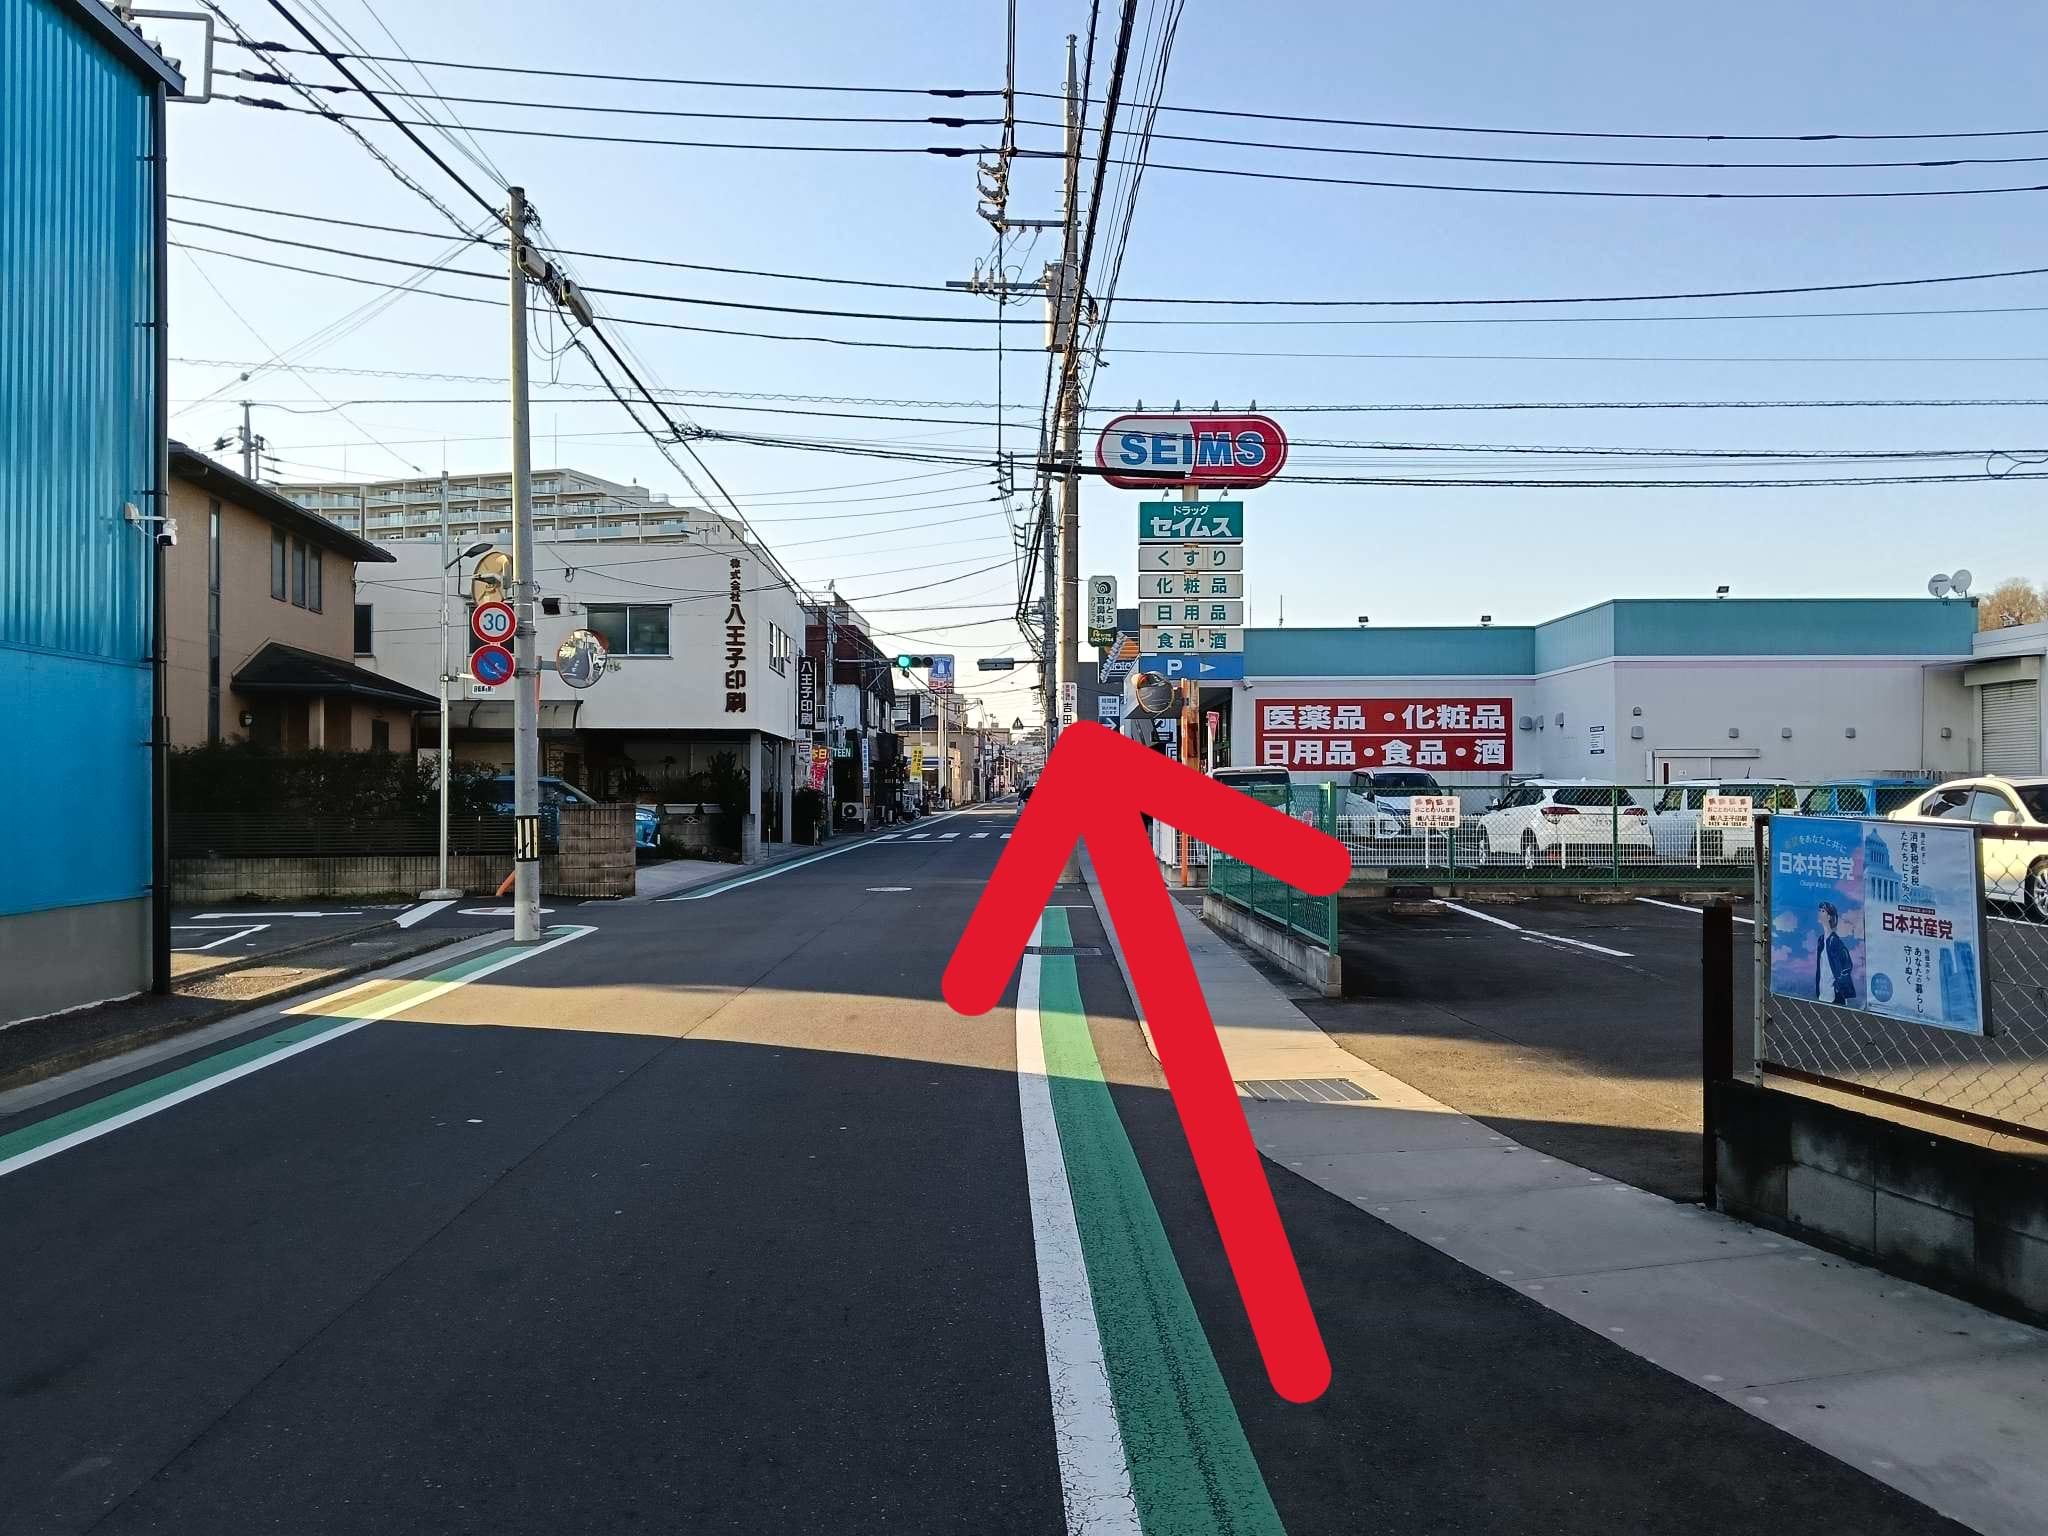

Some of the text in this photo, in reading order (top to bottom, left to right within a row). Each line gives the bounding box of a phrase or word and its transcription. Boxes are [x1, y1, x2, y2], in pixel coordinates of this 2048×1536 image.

[1119, 431, 1265, 467] SEIMS
[1173, 505, 1209, 515] ドラッグ
[1151, 517, 1232, 537] セイムス
[1157, 550, 1227, 567] くすり
[1156, 577, 1228, 594] 化粧品
[1106, 597, 1114, 624] かとう
[1157, 605, 1227, 621] 日用品
[483, 613, 506, 632] 30
[1157, 633, 1227, 650] 食品・酒
[1167, 660, 1182, 675] P
[801, 661, 813, 725] 八王子印刷
[1063, 702, 1072, 728] 吉田
[1263, 739, 1506, 766] 日用品・食品・酒
[1780, 852, 1855, 881] 日本共産党
[1883, 912, 1953, 940] 日本共産党
[1904, 945, 1912, 985] 守りぬく
